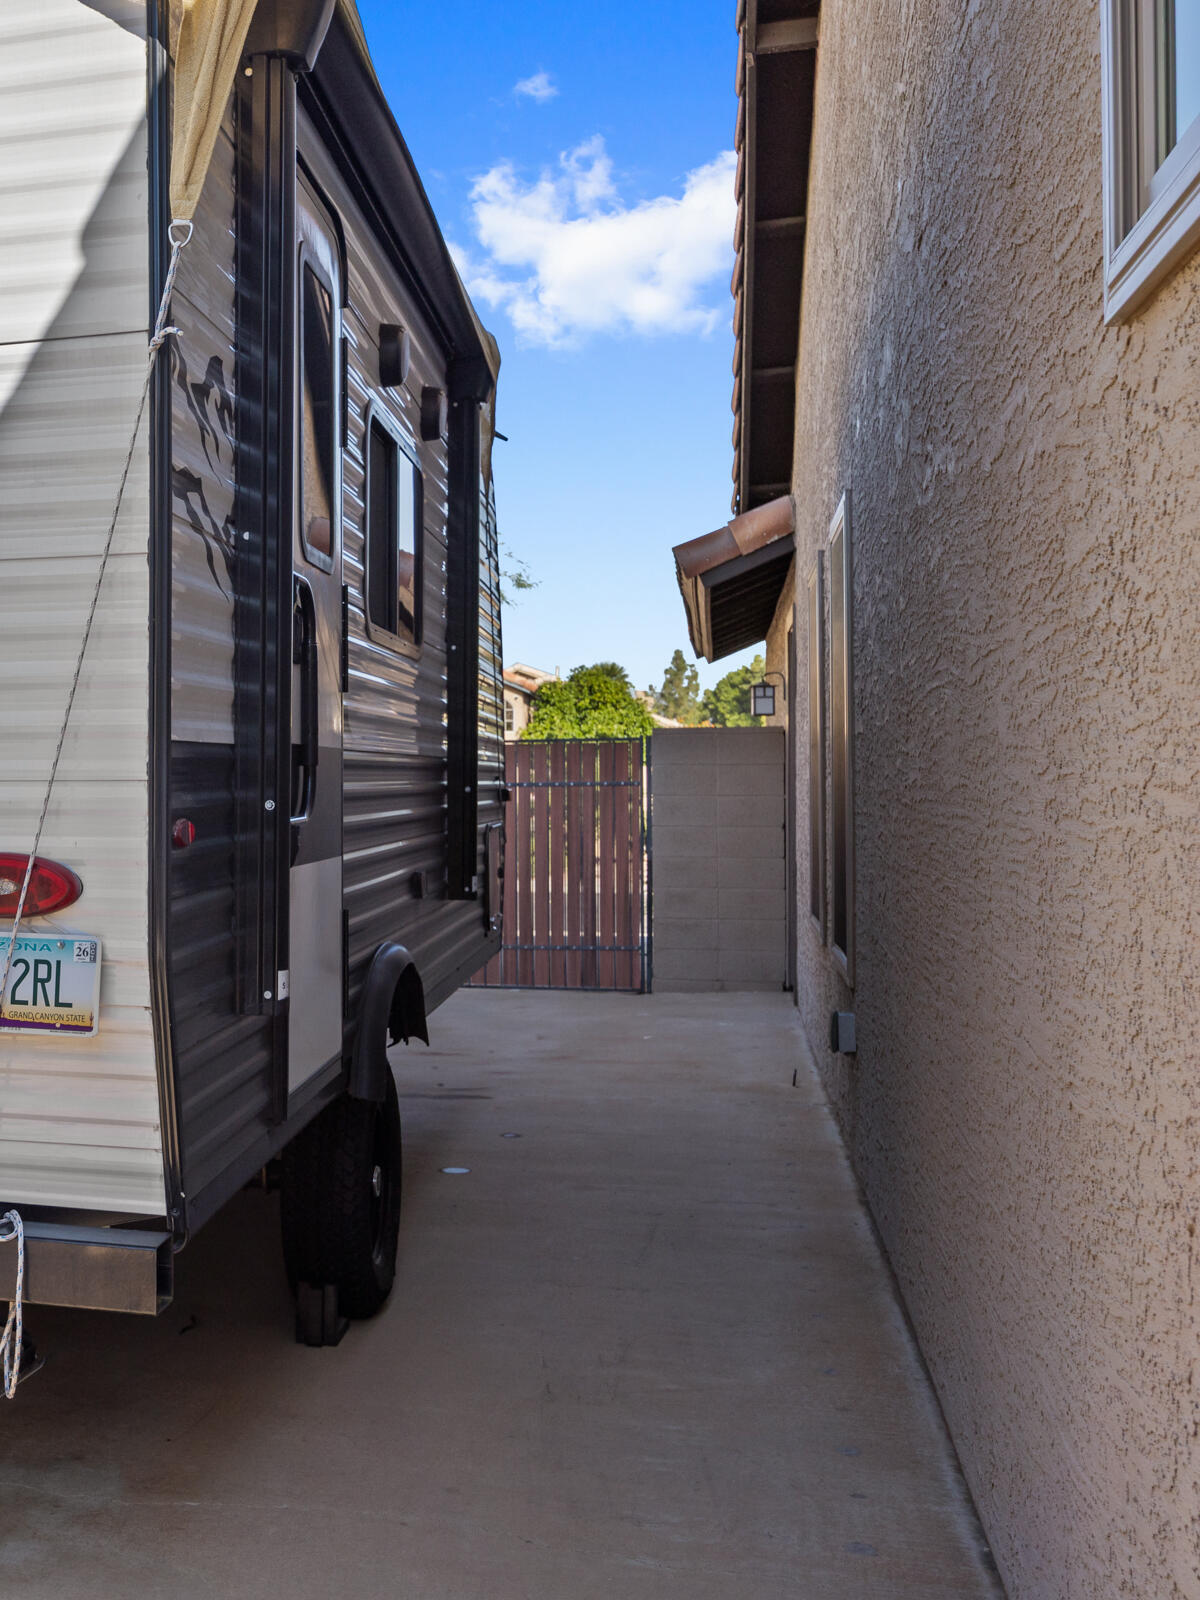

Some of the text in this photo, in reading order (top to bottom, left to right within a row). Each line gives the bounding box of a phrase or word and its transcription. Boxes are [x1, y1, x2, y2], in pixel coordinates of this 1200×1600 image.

[76, 946, 89, 957] 26
[10, 958, 73, 1008] 2RL
[8, 1010, 86, 1022] GRAND CANYON STATE
